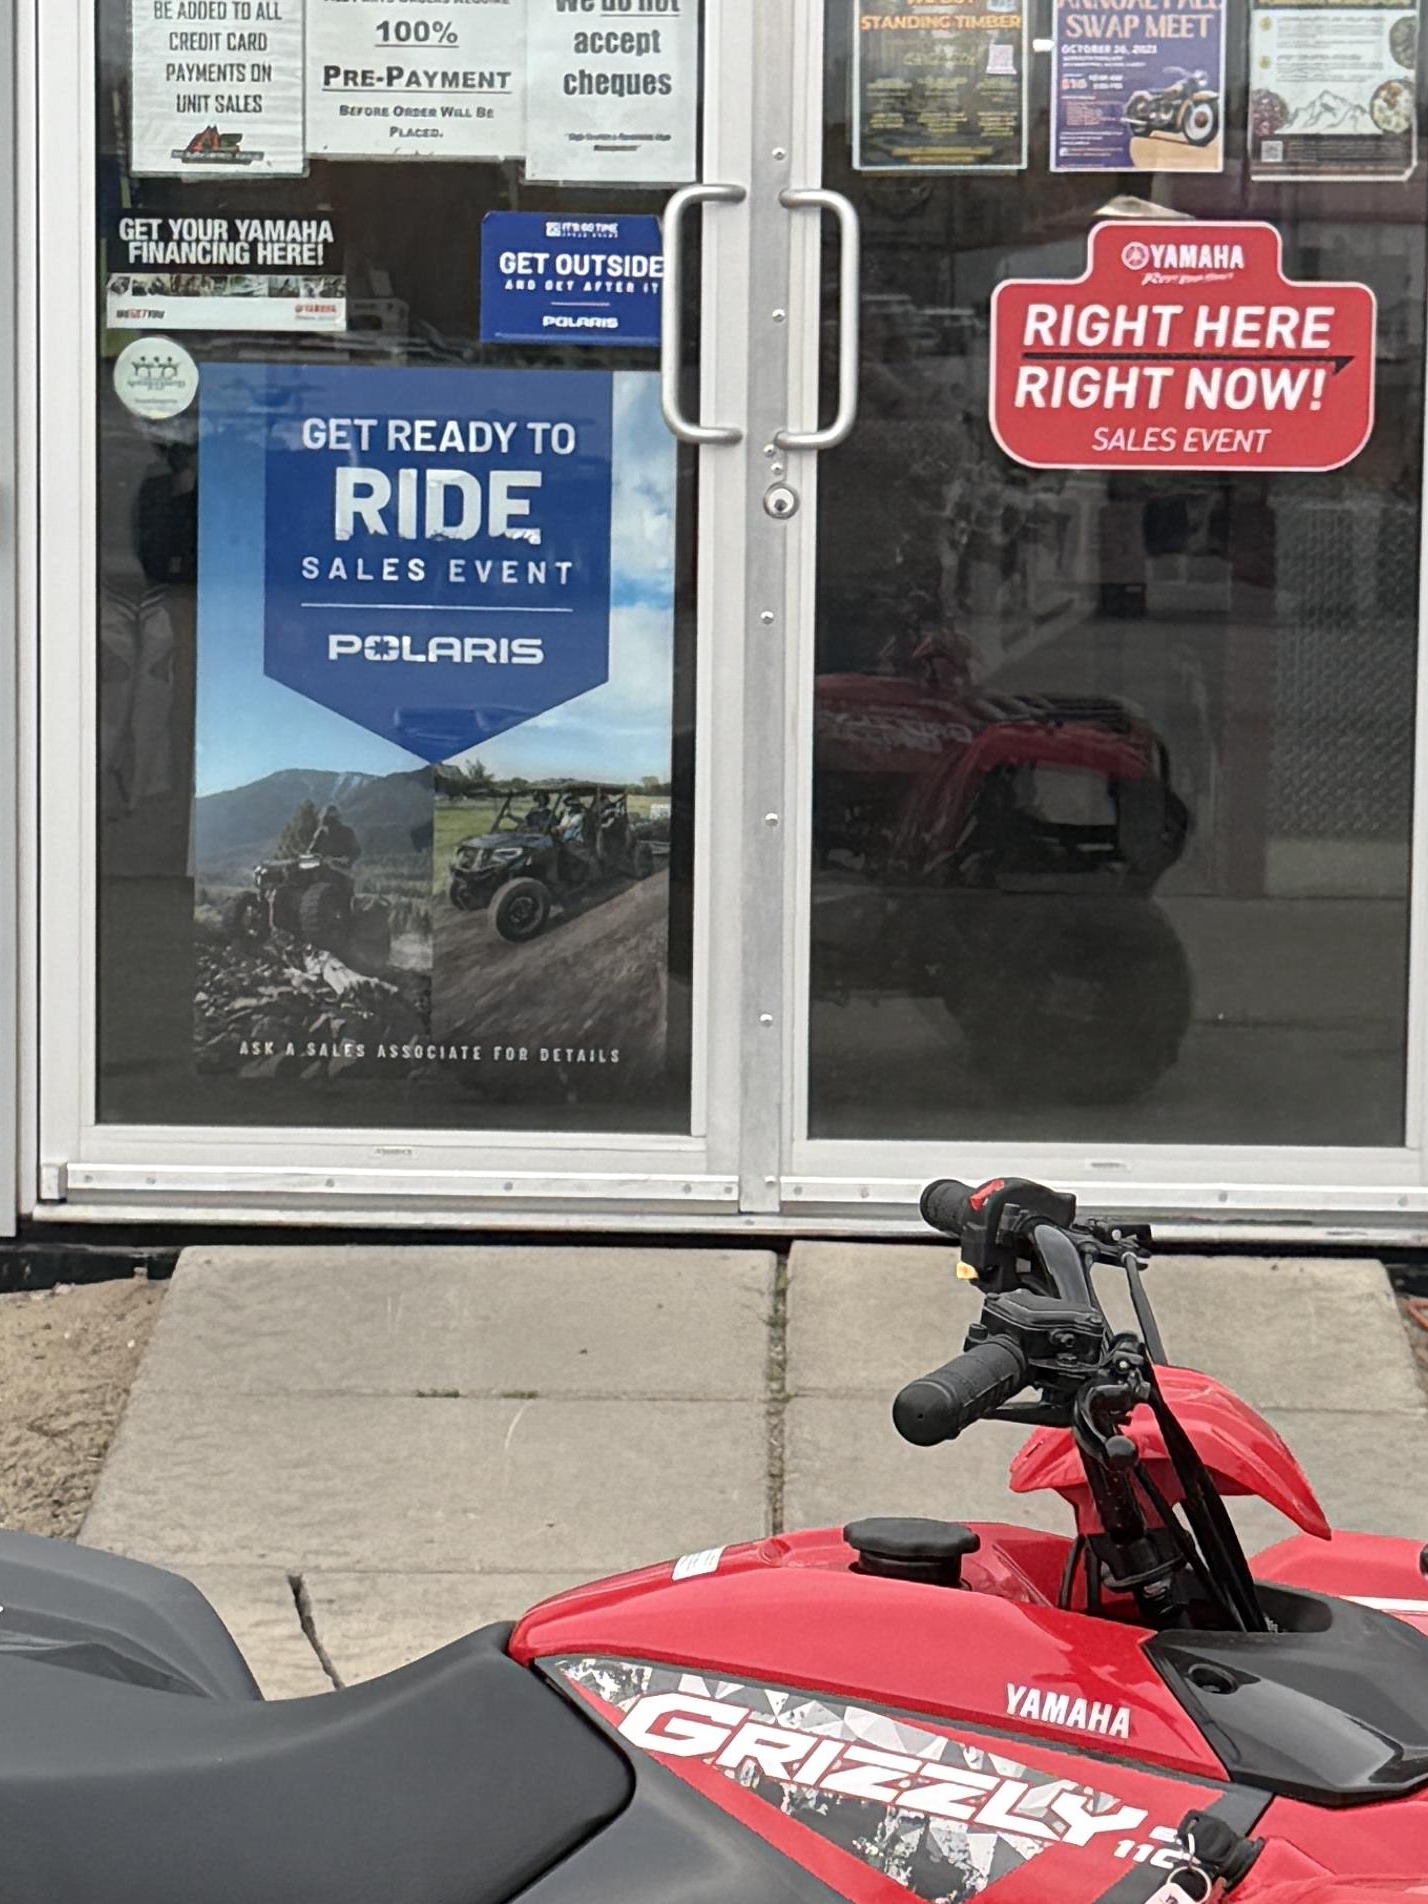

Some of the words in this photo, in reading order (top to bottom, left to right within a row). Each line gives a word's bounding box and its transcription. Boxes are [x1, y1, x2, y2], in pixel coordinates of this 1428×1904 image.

[154, 1, 173, 20] BE
[177, 1, 227, 20] ADDED
[232, 2, 251, 20] TO
[256, 2, 283, 20] ALL
[861, 16, 951, 29] STANDING
[956, 16, 1021, 29] TIMBER
[376, 20, 459, 44] 100%
[1066, 14, 1140, 38] SWAP
[1145, 14, 1213, 38] MEET
[169, 32, 222, 51] CREDIT
[227, 32, 268, 51] CARD
[573, 29, 661, 56] accept
[166, 63, 246, 82] PAYMENTS
[251, 64, 272, 82] ON
[563, 69, 672, 97] cheques
[176, 94, 211, 113] UNIT
[215, 95, 263, 113] SALES
[119, 218, 162, 241] GET
[169, 219, 228, 242] YOUR
[235, 219, 334, 243] YAMAHA
[129, 242, 250, 265] FINANCING
[257, 243, 324, 265] HERE!
[499, 252, 550, 274] GET
[556, 253, 664, 278] OUTSIDE
[1150, 244, 1244, 269] YAMAHA
[505, 279, 536, 290] AND
[545, 280, 574, 291] GET
[583, 281, 634, 293] AFTER
[643, 282, 658, 294] IT
[542, 316, 618, 328] POLARIS
[1023, 303, 1184, 347] RIGHT
[1194, 305, 1336, 349] HERE
[1014, 365, 1174, 409] RIGHT
[1184, 367, 1327, 411] NOW!
[302, 418, 377, 451] GET
[388, 420, 517, 453] READY
[527, 422, 575, 455] TO
[1092, 427, 1177, 453] SALES
[1183, 428, 1272, 454] EVENT
[335, 466, 543, 544] RIDE
[302, 556, 425, 581] SALES
[449, 559, 573, 585] EVENT
[328, 634, 545, 665] POLARIS
[240, 1041, 274, 1056] ASK
[286, 1043, 295, 1056] A
[307, 1043, 366, 1058] SALES
[377, 1044, 482, 1061] ASSOCIATE
[493, 1046, 528, 1062] FOR
[539, 1048, 621, 1064] DETAILS
[1005, 1683, 1131, 1739] YAMAHA
[618, 1692, 1148, 1846] GRIZZLY
